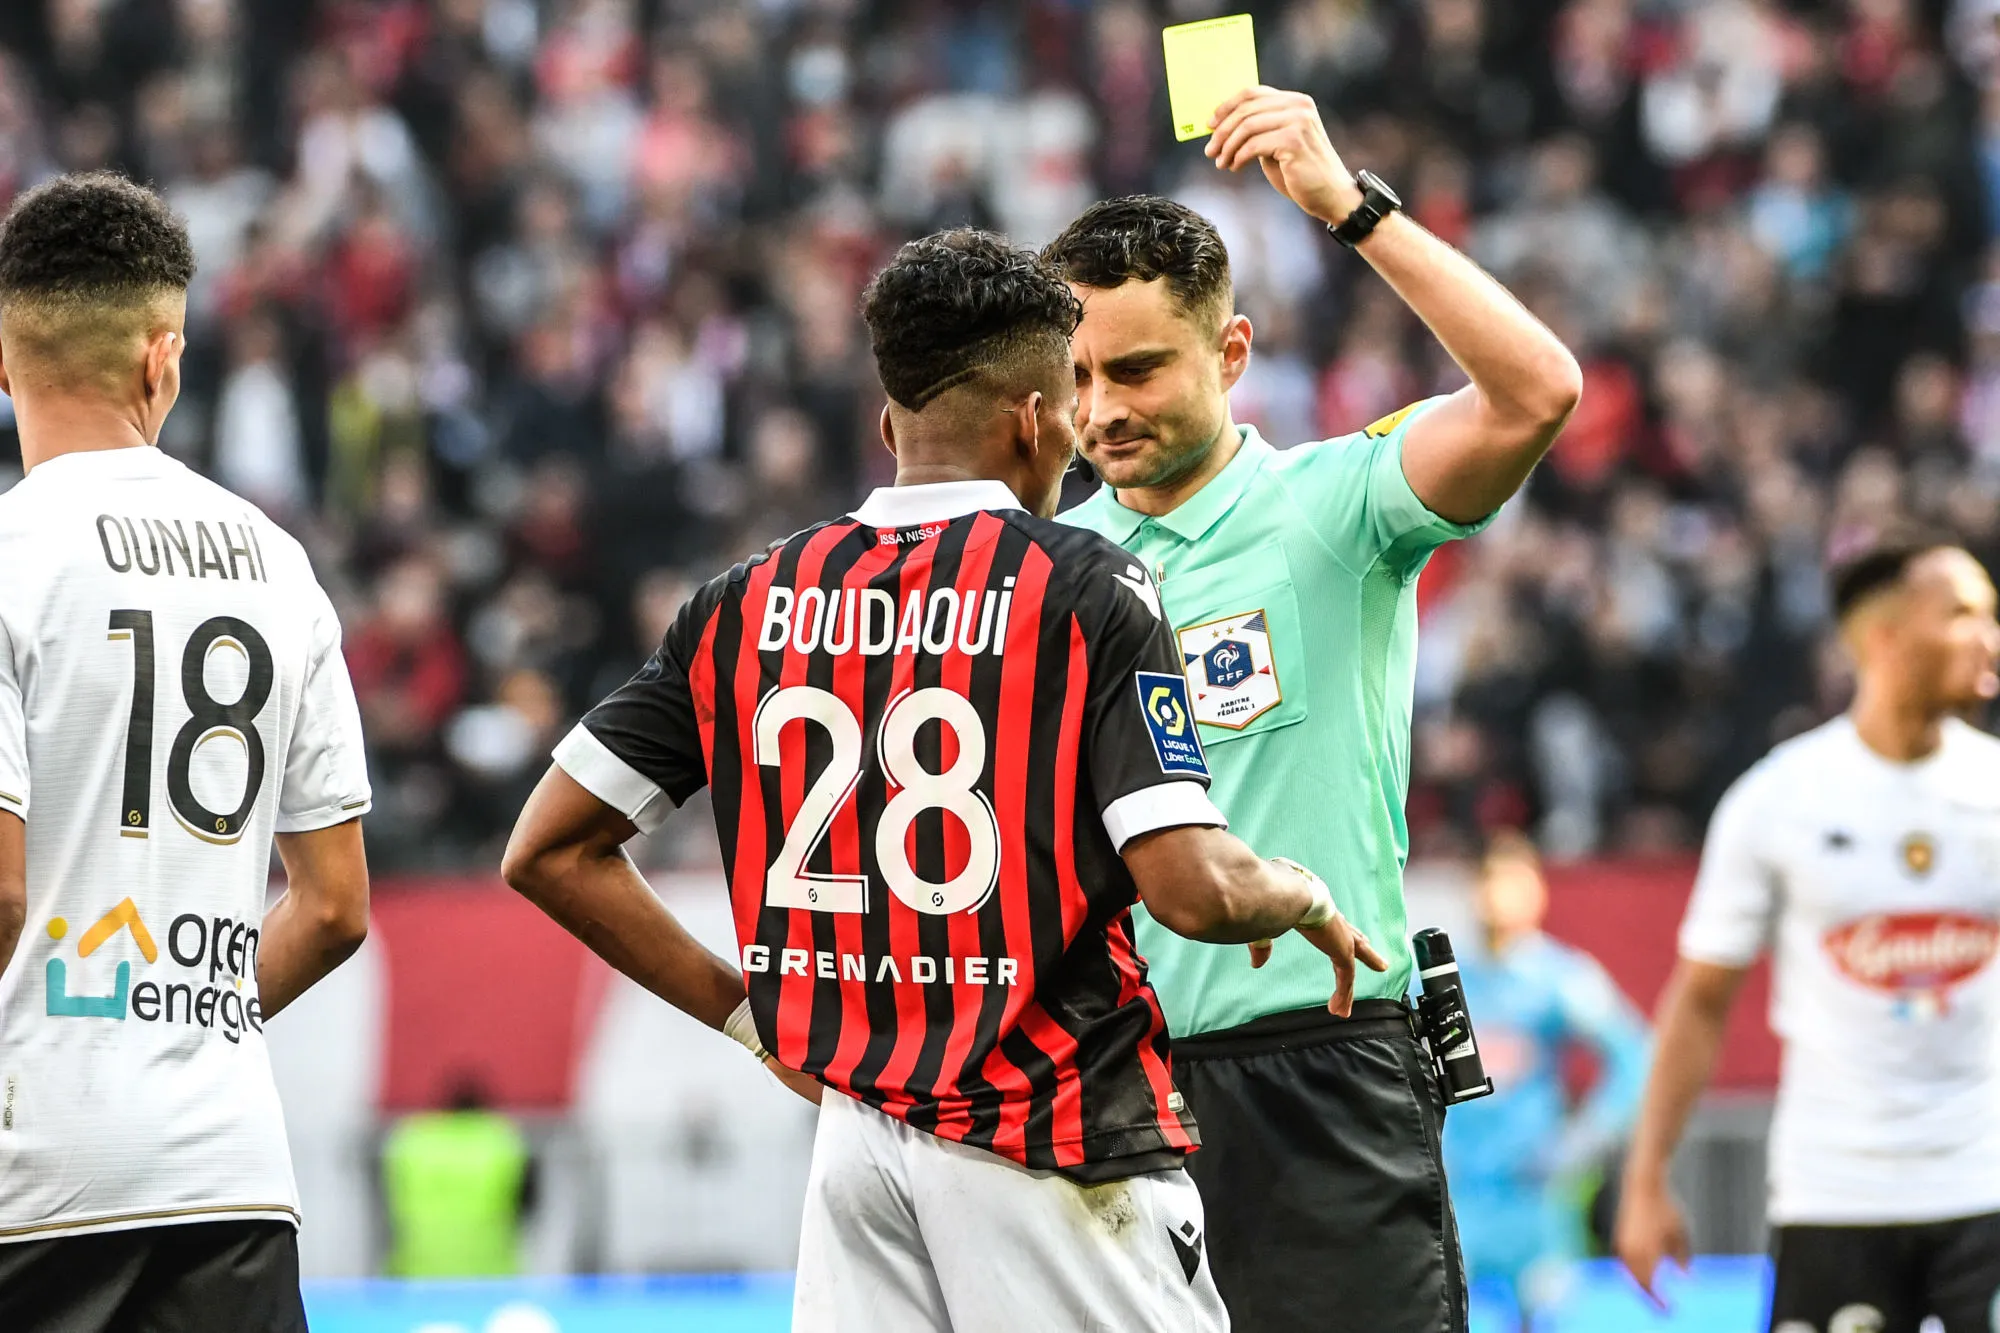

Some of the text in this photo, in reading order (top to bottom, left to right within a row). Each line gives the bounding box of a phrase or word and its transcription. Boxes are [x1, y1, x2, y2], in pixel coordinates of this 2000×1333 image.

[880, 525, 942, 546] ISSA NISSA
[1217, 669, 1244, 684] FFF
[1220, 696, 1250, 709] ARBITRE
[107, 609, 274, 846] 18
[1162, 739, 1190, 752] LIGUE
[1163, 751, 1185, 763] Uber
[752, 684, 1001, 916] 28
[168, 913, 259, 983] open
[742, 944, 1018, 986] GRENADIER
[131, 979, 263, 1044] energie
